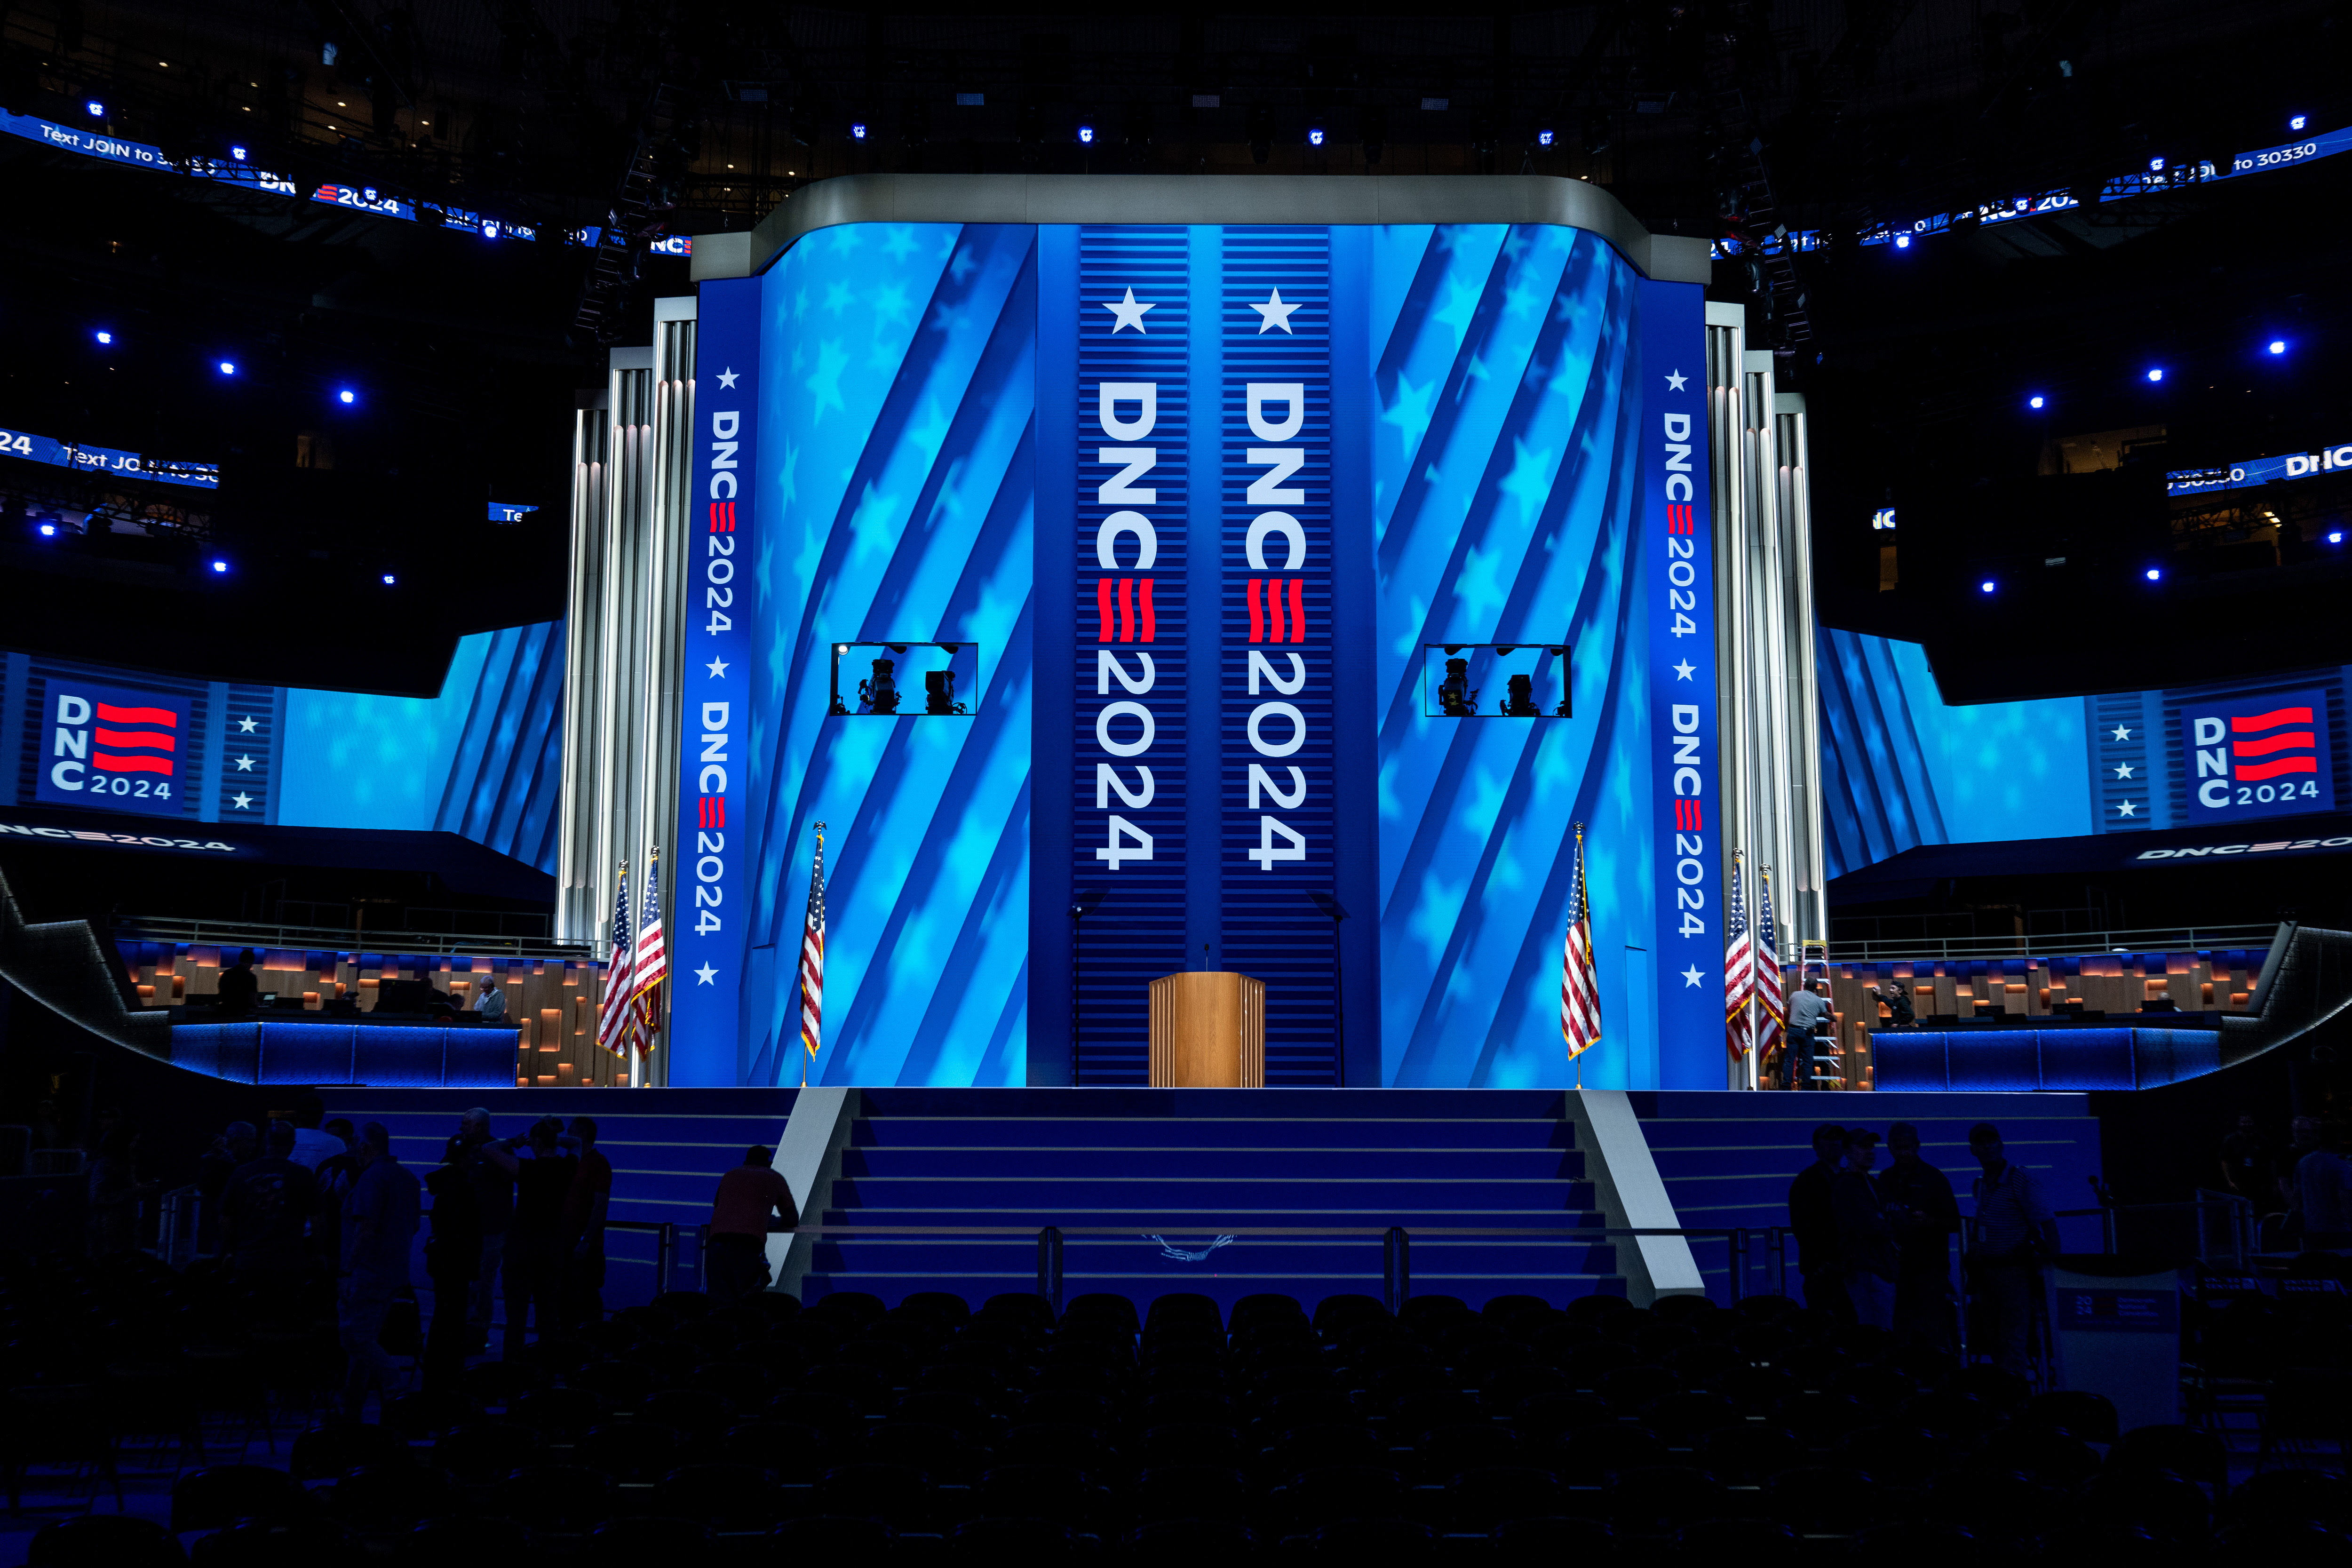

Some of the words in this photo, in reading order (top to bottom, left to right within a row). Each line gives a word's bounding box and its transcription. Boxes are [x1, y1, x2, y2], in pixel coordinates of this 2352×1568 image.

[40, 124, 80, 146] Text
[83, 138, 130, 158] JOIN
[134, 148, 153, 162] to
[2233, 159, 2253, 170] to
[2257, 143, 2316, 166] 30330
[63, 446, 108, 467] Text
[710, 411, 739, 499] DNC
[1097, 382, 1157, 569] DNC
[1246, 382, 1306, 570] DNC
[1664, 413, 1693, 501] DNC
[706, 535, 735, 636] 2024
[1668, 537, 1696, 638] 2024
[51, 694, 91, 791] DNC
[90, 775, 172, 800] 2024
[699, 701, 730, 793] DNC
[1096, 650, 1155, 870] 2024
[1247, 650, 1306, 871] 2024
[1672, 704, 1701, 796] DNC
[2194, 717, 2230, 808] DNC
[2236, 780, 2319, 805] 2024
[111, 835, 236, 851] 2024
[694, 831, 724, 936] 2024
[1676, 833, 1705, 939] 2024
[2136, 845, 2250, 860] DNC
